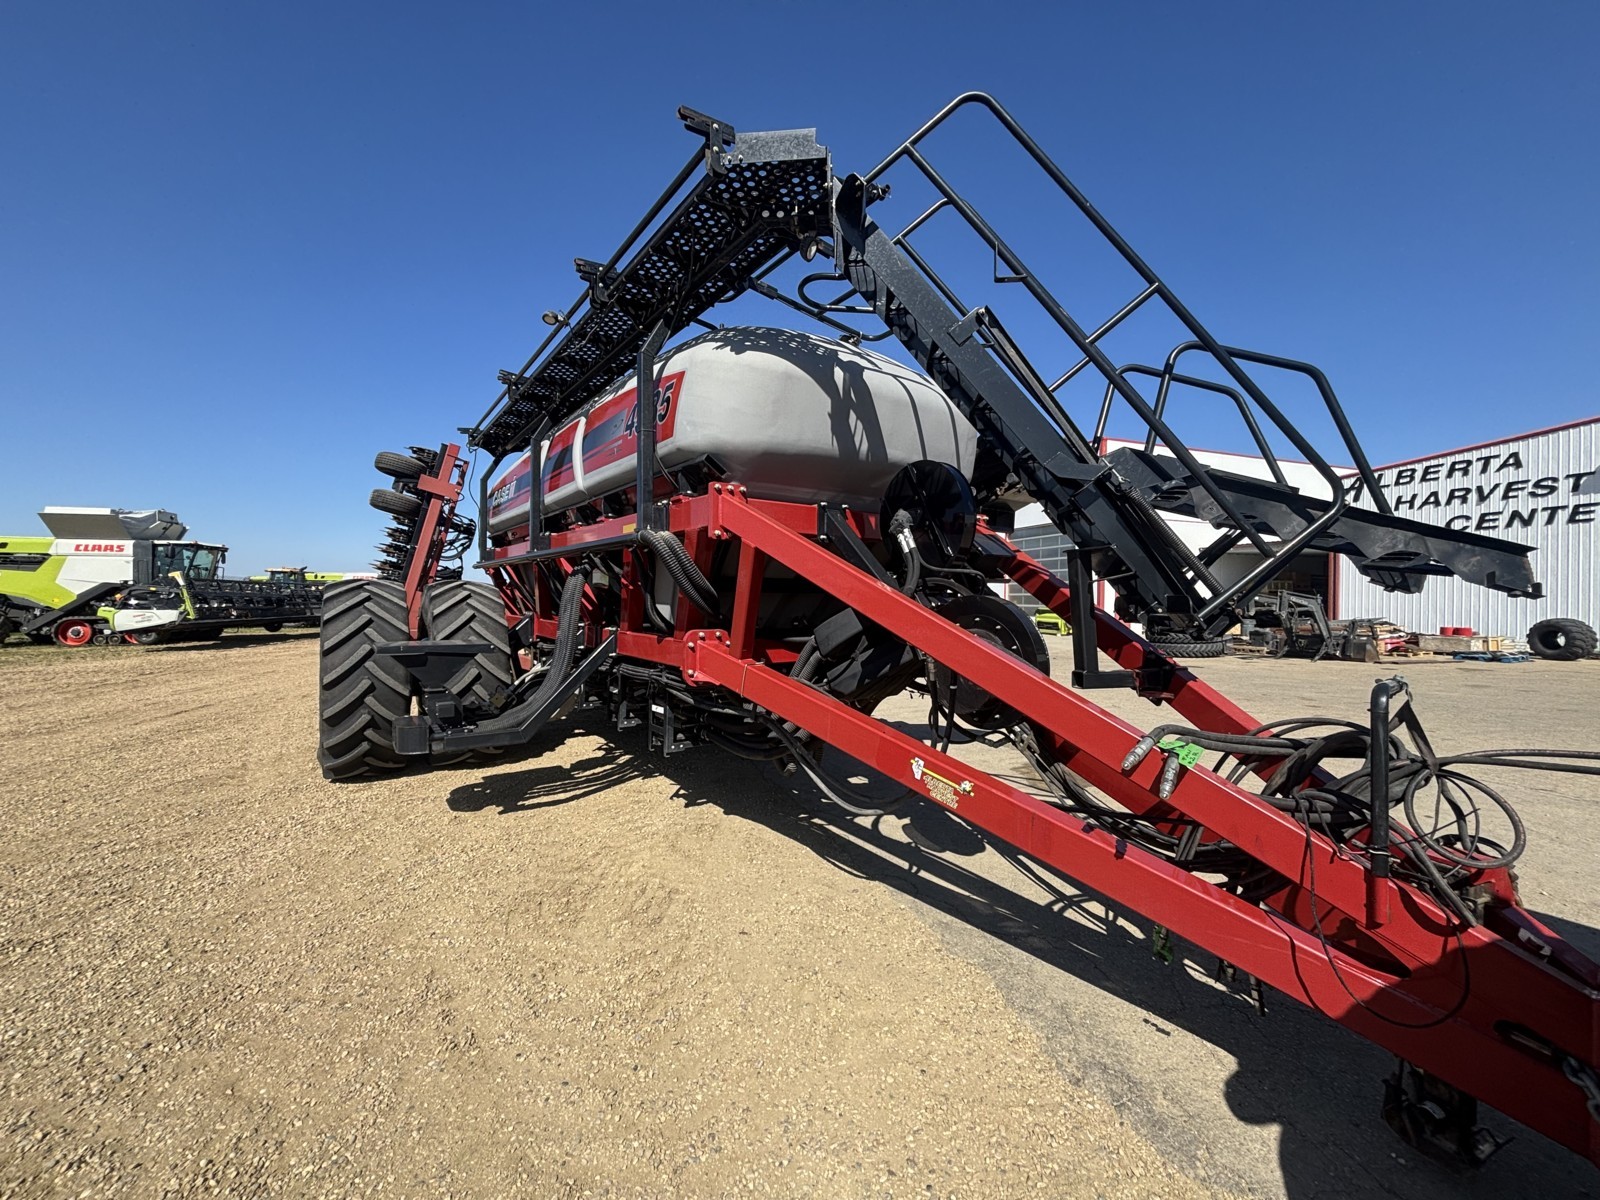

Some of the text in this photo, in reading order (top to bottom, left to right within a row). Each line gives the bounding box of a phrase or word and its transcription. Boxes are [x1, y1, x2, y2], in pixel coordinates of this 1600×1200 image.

[1344, 452, 1523, 503] ALBERTA
[1394, 471, 1596, 511] HARVEST
[74, 544, 125, 552] CLAAS
